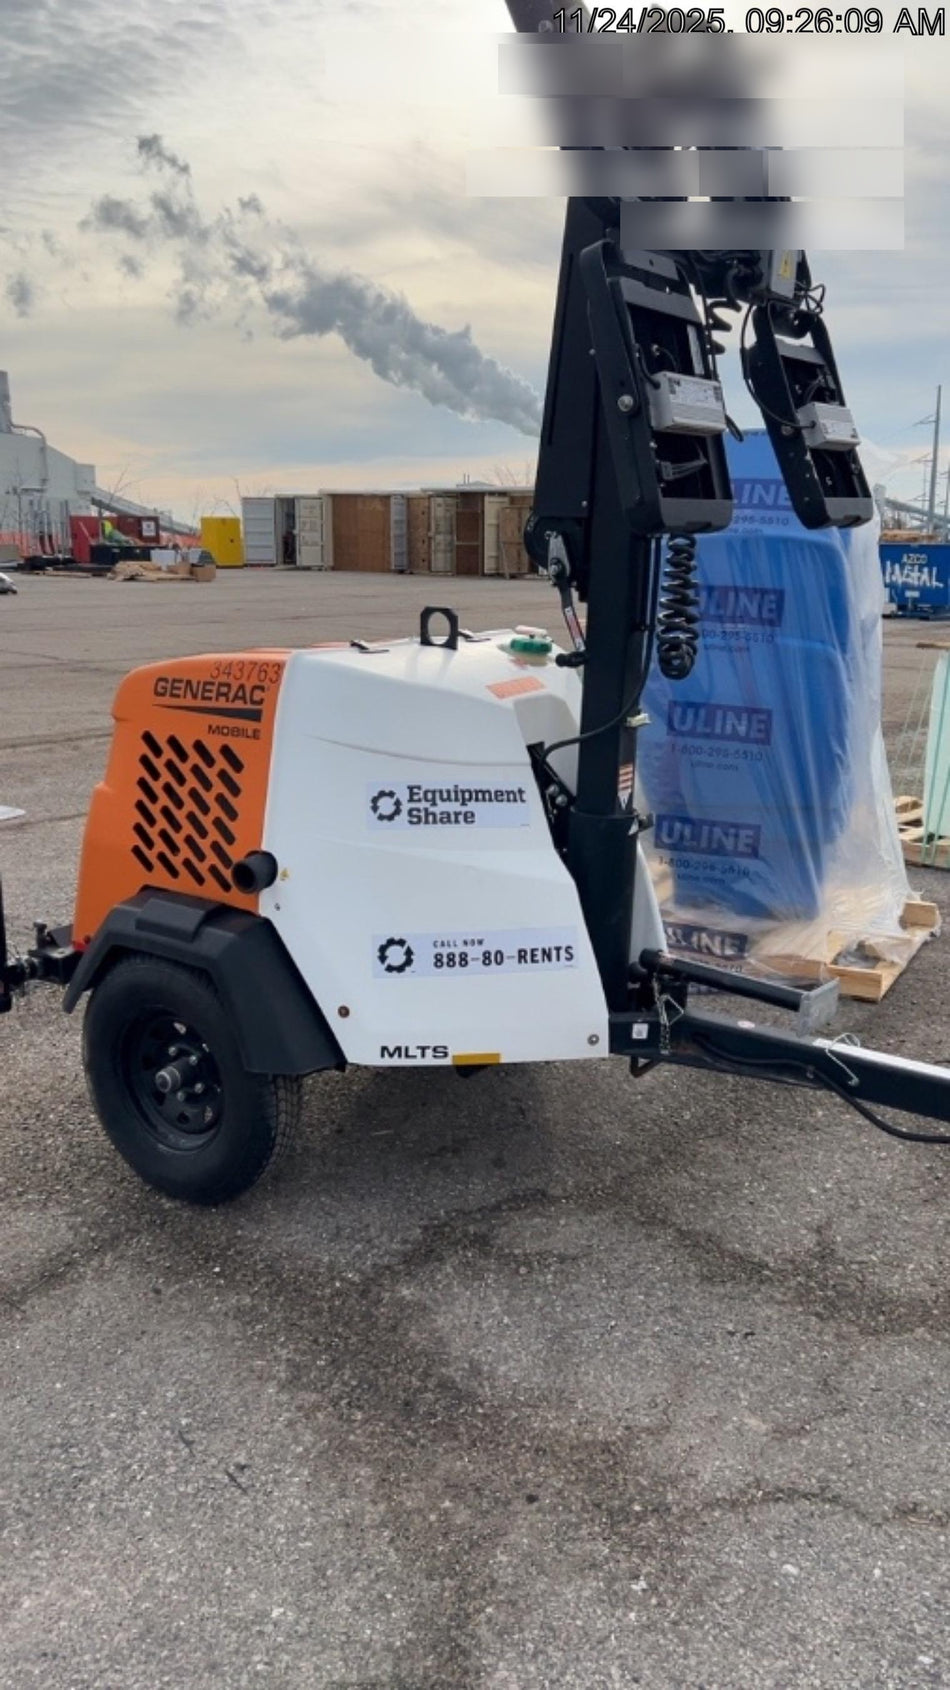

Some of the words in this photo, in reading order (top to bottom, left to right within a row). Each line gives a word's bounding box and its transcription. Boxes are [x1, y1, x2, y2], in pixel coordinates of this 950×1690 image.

[210, 660, 281, 684] 343763
[153, 677, 265, 706] GENERAC
[207, 724, 261, 740] MOBILE
[673, 706, 768, 739] ULINE
[407, 785, 526, 806] Equipment
[407, 807, 476, 825] Share
[661, 820, 754, 853] ULINE
[433, 939, 458, 948] CALL
[463, 938, 485, 947] NOW
[433, 945, 575, 969] 888-80-RENTS
[380, 1045, 450, 1059] MLTS
